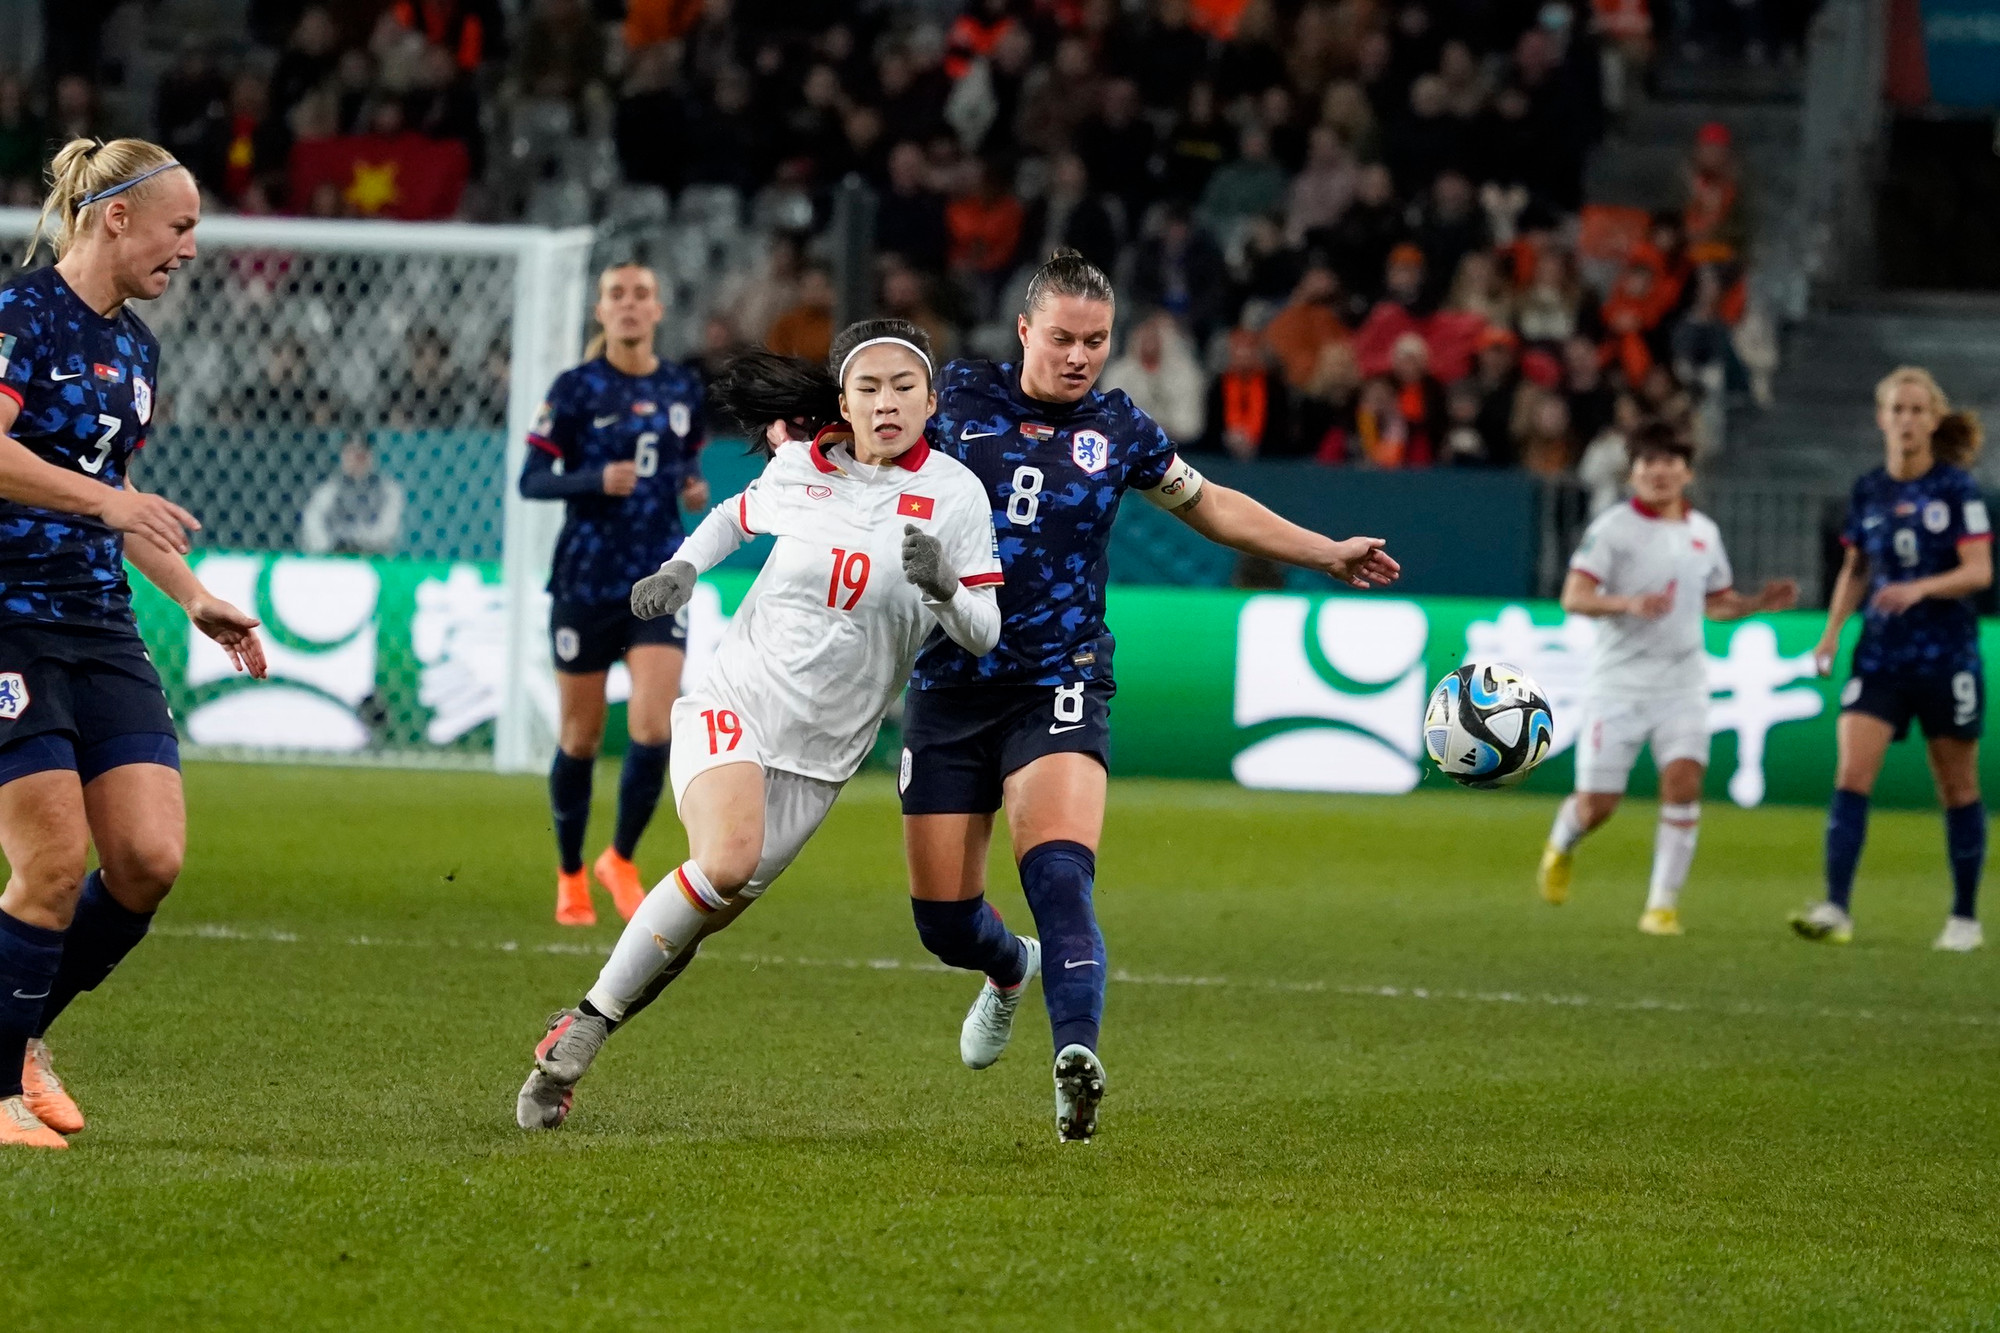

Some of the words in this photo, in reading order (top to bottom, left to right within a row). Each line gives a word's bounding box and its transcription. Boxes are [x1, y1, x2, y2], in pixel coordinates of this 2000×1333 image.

[78, 413, 122, 474] 3
[634, 432, 659, 478] 6
[1006, 465, 1044, 526] 8
[1894, 529, 1918, 567] 9
[827, 548, 870, 611] 19
[1053, 681, 1085, 723] 8
[1952, 671, 1976, 714] 9
[700, 709, 743, 755] 19
